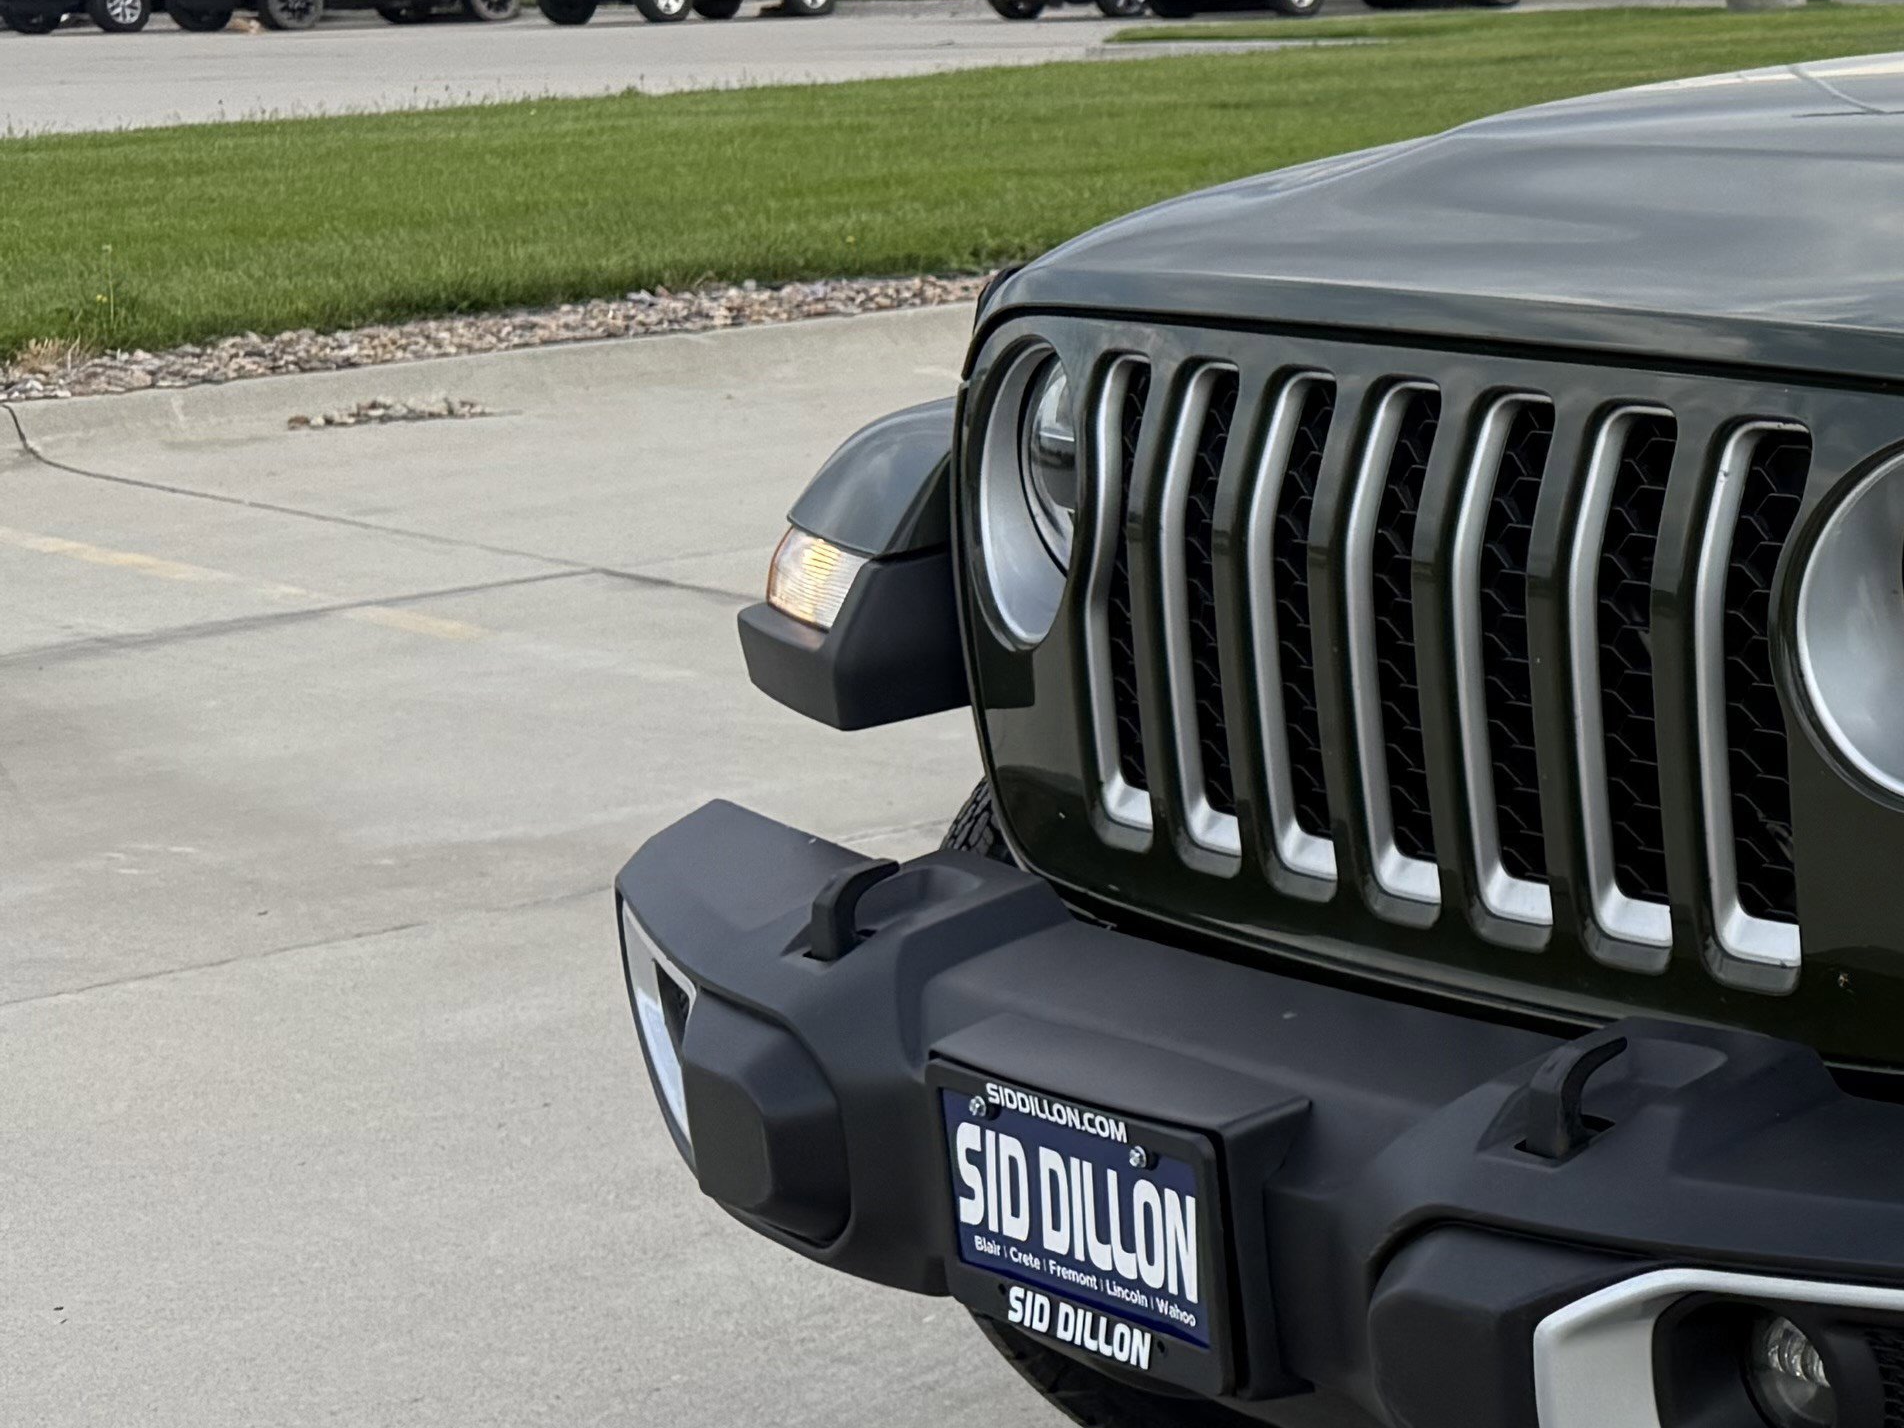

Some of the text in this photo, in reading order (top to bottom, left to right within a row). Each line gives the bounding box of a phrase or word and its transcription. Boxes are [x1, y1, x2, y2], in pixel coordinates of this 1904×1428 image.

[985, 1083, 1128, 1144] SIDDILLON.COM
[956, 1122, 1198, 1303] SID DILLON
[974, 1235, 1196, 1327] Blair Crete Fremont Lincoln Wahoo
[1007, 1286, 1153, 1371] SID DILLON
